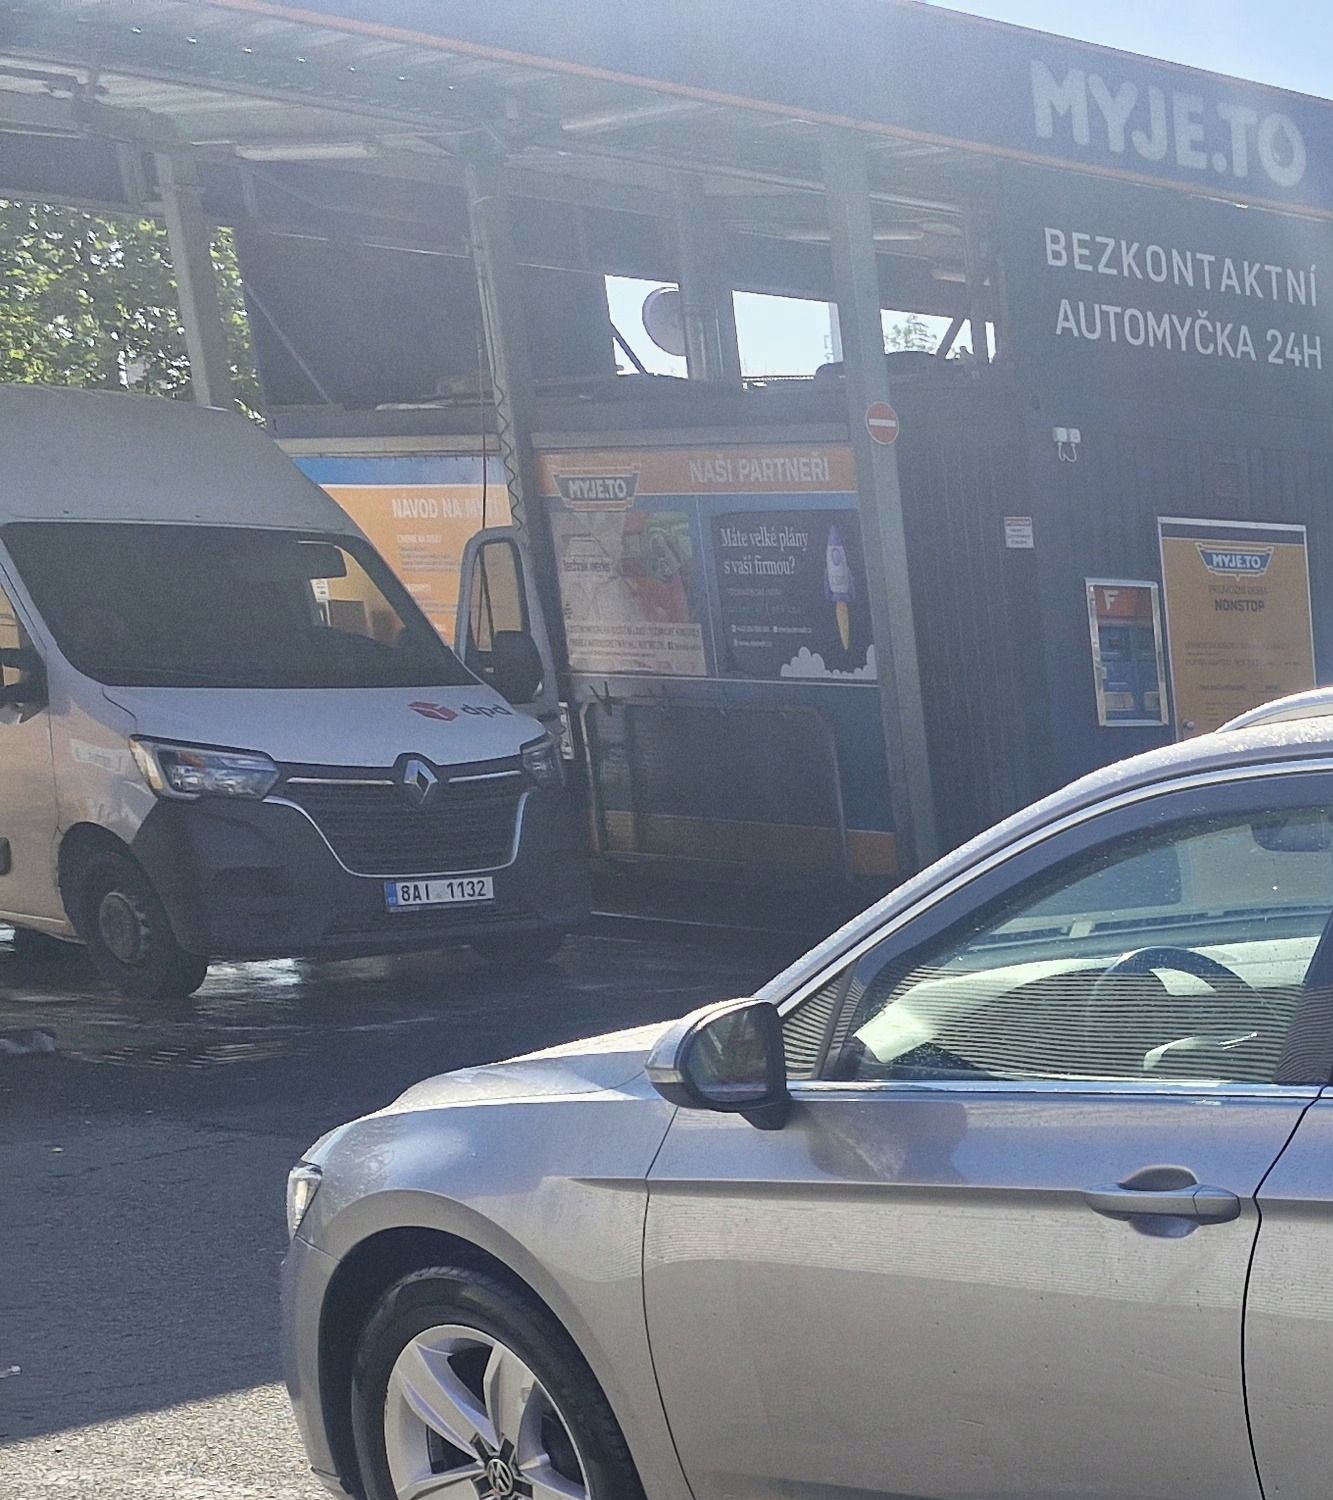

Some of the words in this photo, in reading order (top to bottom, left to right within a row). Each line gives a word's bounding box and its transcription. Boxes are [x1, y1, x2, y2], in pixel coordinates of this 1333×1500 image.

[1031, 60, 1307, 188] MYJE.TO
[1044, 227, 1318, 307] BEZKONTAKTNÍ
[1055, 299, 1257, 361] AUTOMYČKA
[1267, 328, 1323, 370] 24H
[689, 456, 734, 484] NAŠI
[739, 453, 830, 483] PARTNEŘI
[568, 478, 627, 501] MYJE.TO
[720, 526, 748, 548] Máte
[749, 524, 778, 547] velké
[780, 524, 808, 552] plány
[755, 552, 796, 576] firmou?
[1211, 553, 1262, 570] MYJE.TO
[1214, 598, 1266, 614] NONSTOP
[460, 703, 513, 721] dpd
[400, 883, 431, 903] 8AI
[446, 879, 487, 900] 1132
